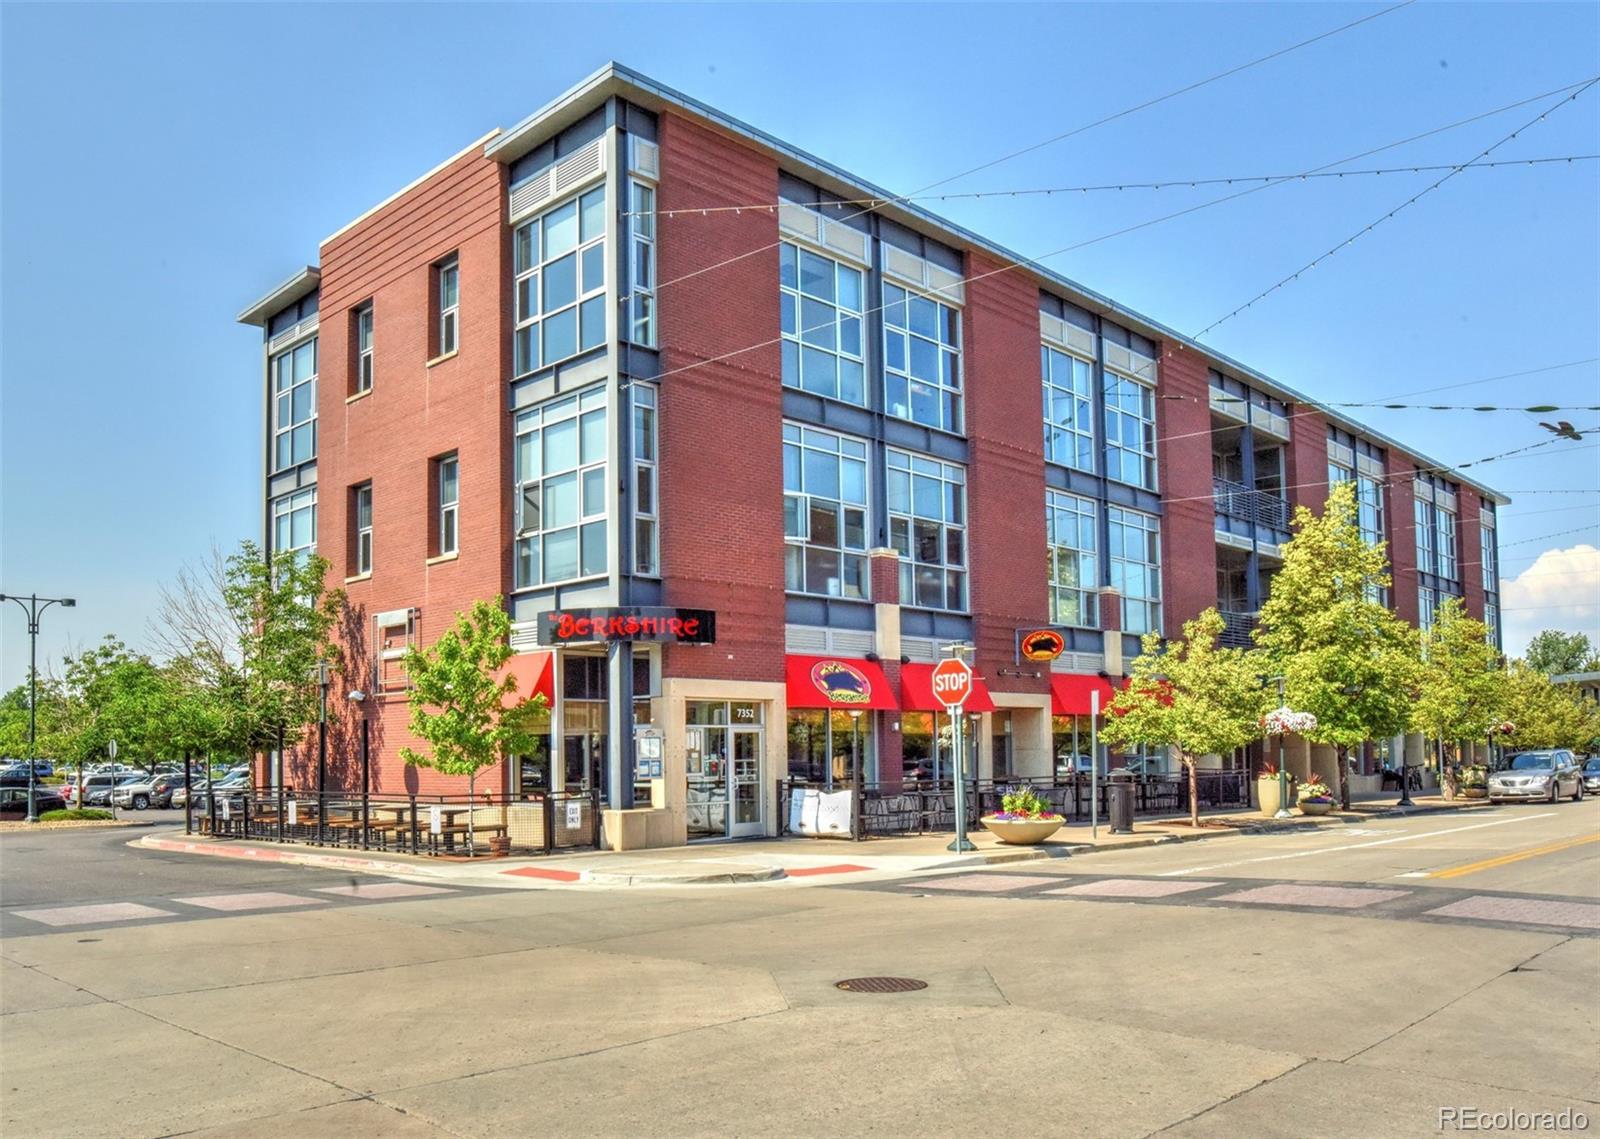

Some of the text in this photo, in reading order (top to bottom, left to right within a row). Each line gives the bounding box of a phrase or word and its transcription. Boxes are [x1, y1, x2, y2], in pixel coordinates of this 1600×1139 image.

[935, 672, 967, 692] STOP
[736, 708, 754, 719] 7352
[568, 807, 578, 816] EXIT
[568, 816, 579, 825] ONLY
